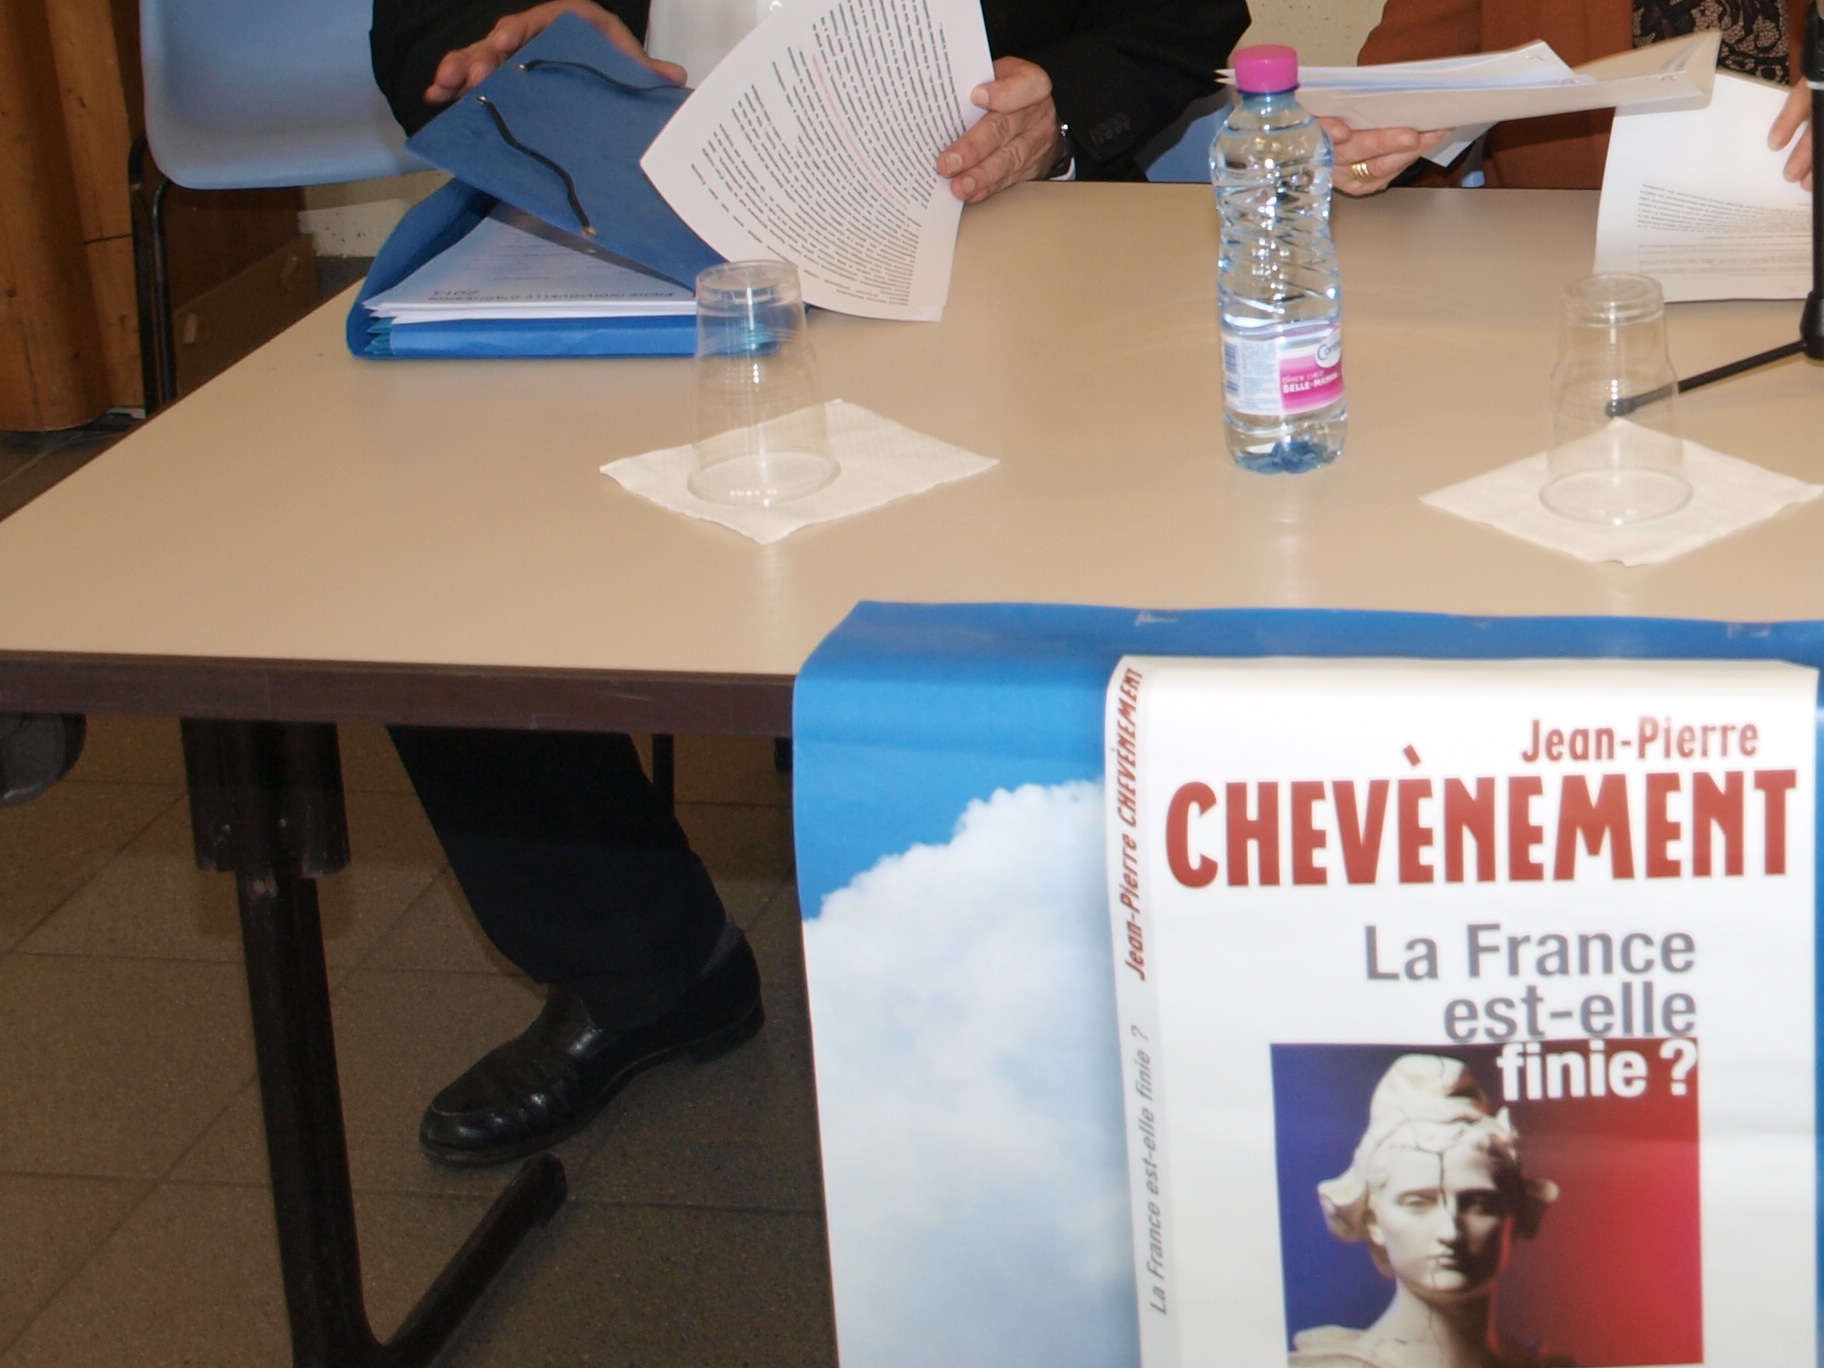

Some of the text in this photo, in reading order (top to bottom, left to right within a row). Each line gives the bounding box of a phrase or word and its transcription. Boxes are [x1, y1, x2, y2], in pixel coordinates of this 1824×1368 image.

[1521, 716, 1759, 763] Jean-Pierre
[1111, 667, 1146, 982] Jean-Pierre CHEVÈNEMENT
[1165, 743, 1797, 889] CHEVÈNEMENT
[1364, 923, 1697, 980] La France
[1443, 981, 1697, 1044] est-elle
[1133, 1049, 1154, 1103] finie
[1497, 1037, 1698, 1101] finie ?
[1137, 1107, 1160, 1196] est-elle
[1146, 1201, 1166, 1279] France
[1150, 1282, 1167, 1315] La
